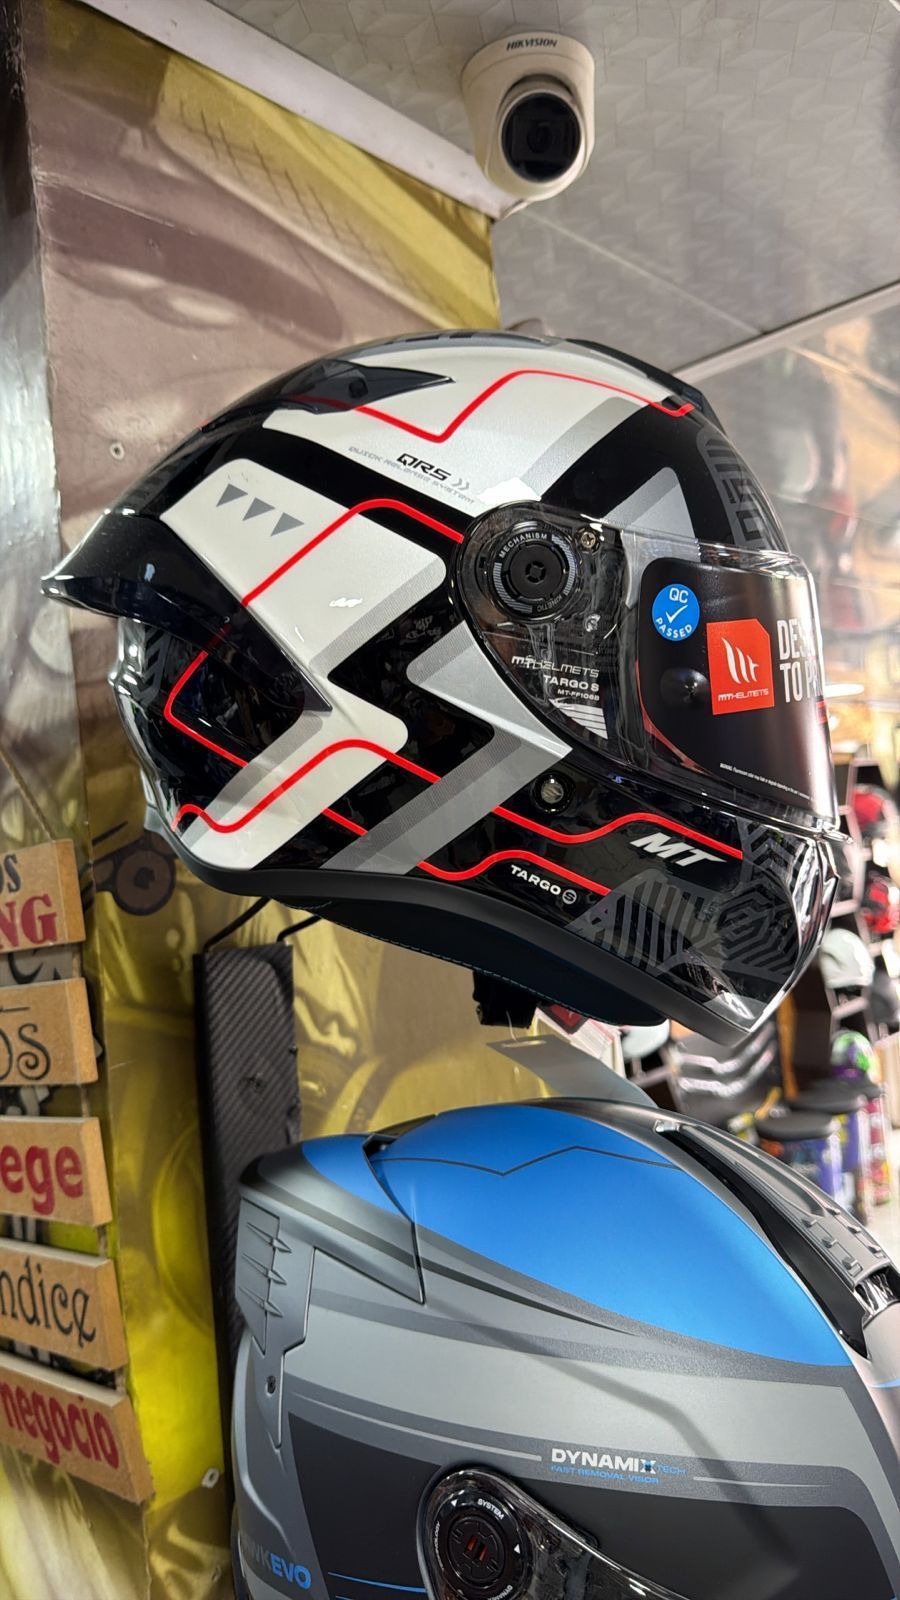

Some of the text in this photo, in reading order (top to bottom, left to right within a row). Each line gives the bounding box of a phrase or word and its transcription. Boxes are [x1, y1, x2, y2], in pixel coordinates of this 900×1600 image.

[506, 38, 558, 51] HIKVISION
[396, 452, 452, 481] QRS
[499, 532, 548, 559] MECHANISM
[537, 593, 563, 613] KINETIC
[669, 587, 689, 604] QC
[655, 616, 693, 639] PASSED
[543, 674, 600, 692] TARGO S
[779, 661, 802, 703] TO
[629, 831, 728, 867] MT
[510, 864, 562, 897] TARGO
[0, 1380, 119, 1470] negocio
[577, 1467, 625, 1481] REMOVAL
[627, 1474, 659, 1485] VISOR
[477, 1498, 504, 1520] SYSTEM
